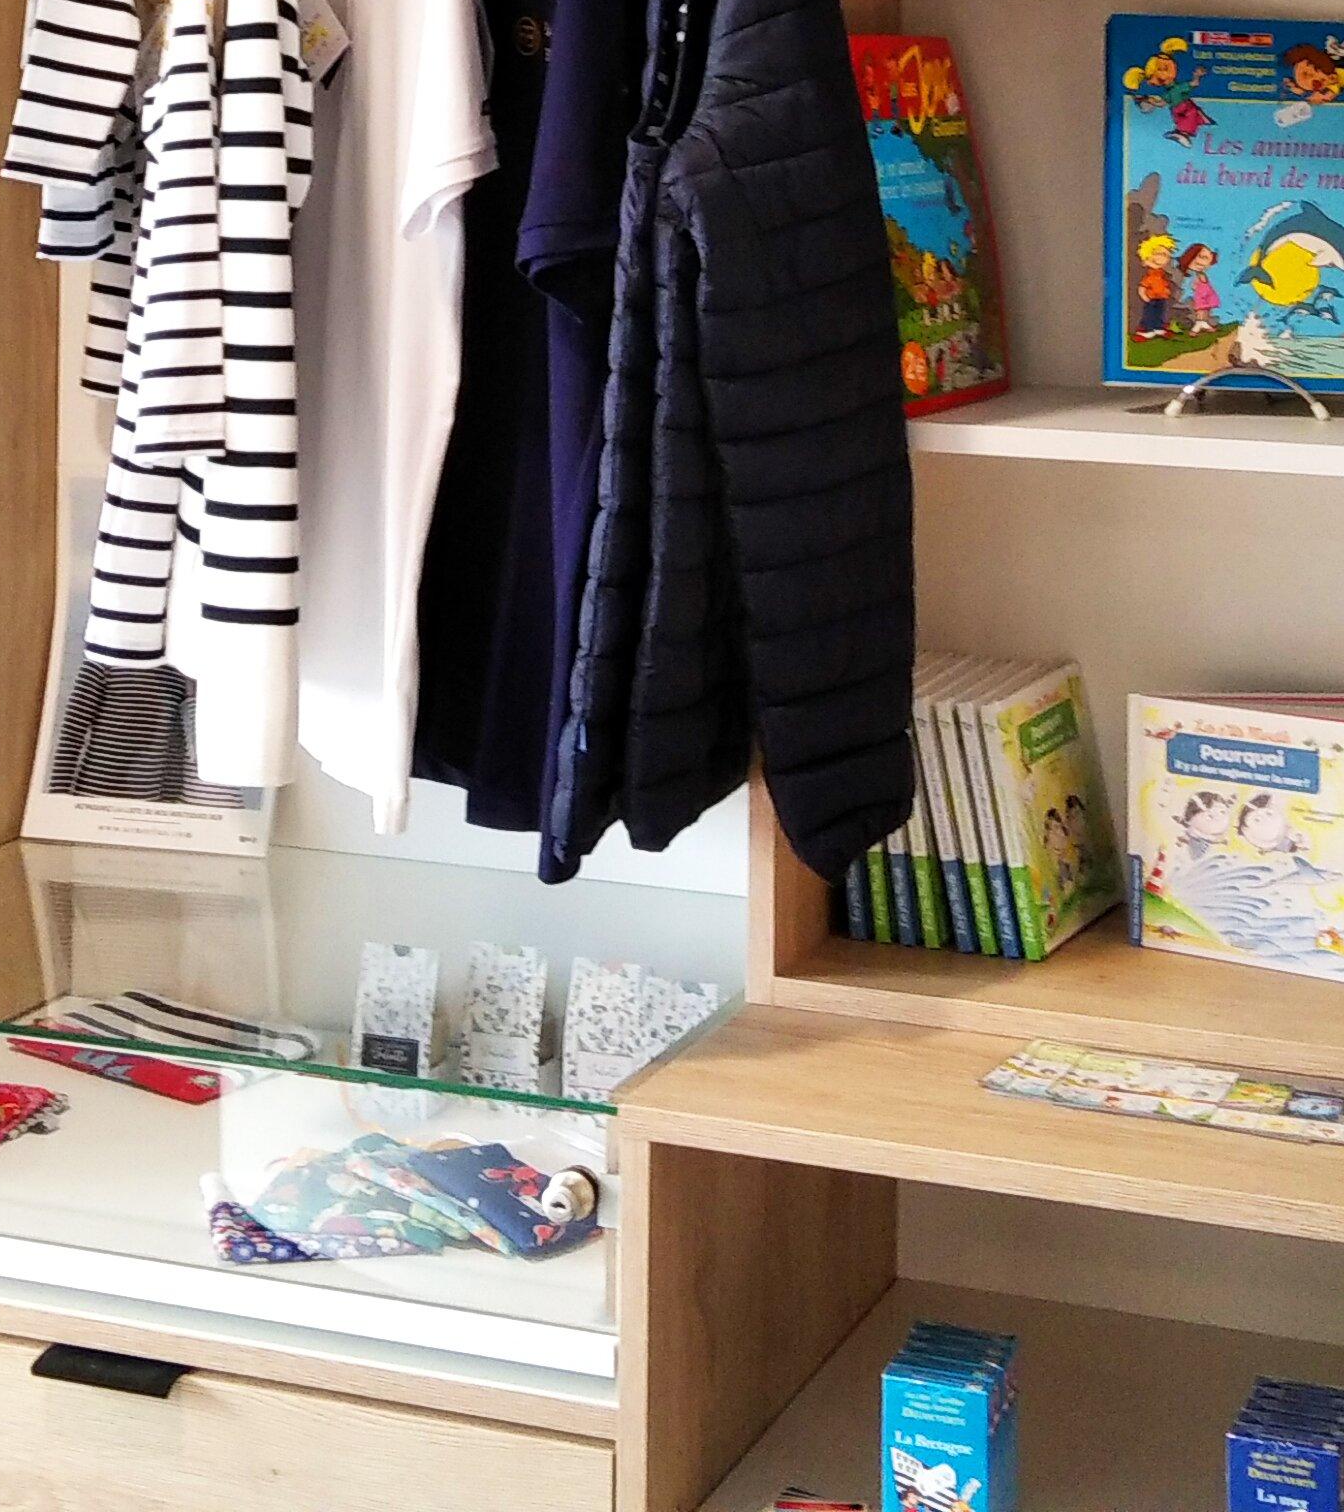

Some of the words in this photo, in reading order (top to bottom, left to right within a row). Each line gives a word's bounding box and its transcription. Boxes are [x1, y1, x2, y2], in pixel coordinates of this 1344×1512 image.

[1204, 132, 1243, 155] Les
[1176, 161, 1206, 184] du
[1218, 162, 1273, 187] bord
[1280, 165, 1308, 188] de
[1199, 743, 1285, 769] Pourquoi
[895, 1430, 913, 1445] La
[914, 1433, 974, 1457] Bretagne
[1256, 1487, 1277, 1504] La
